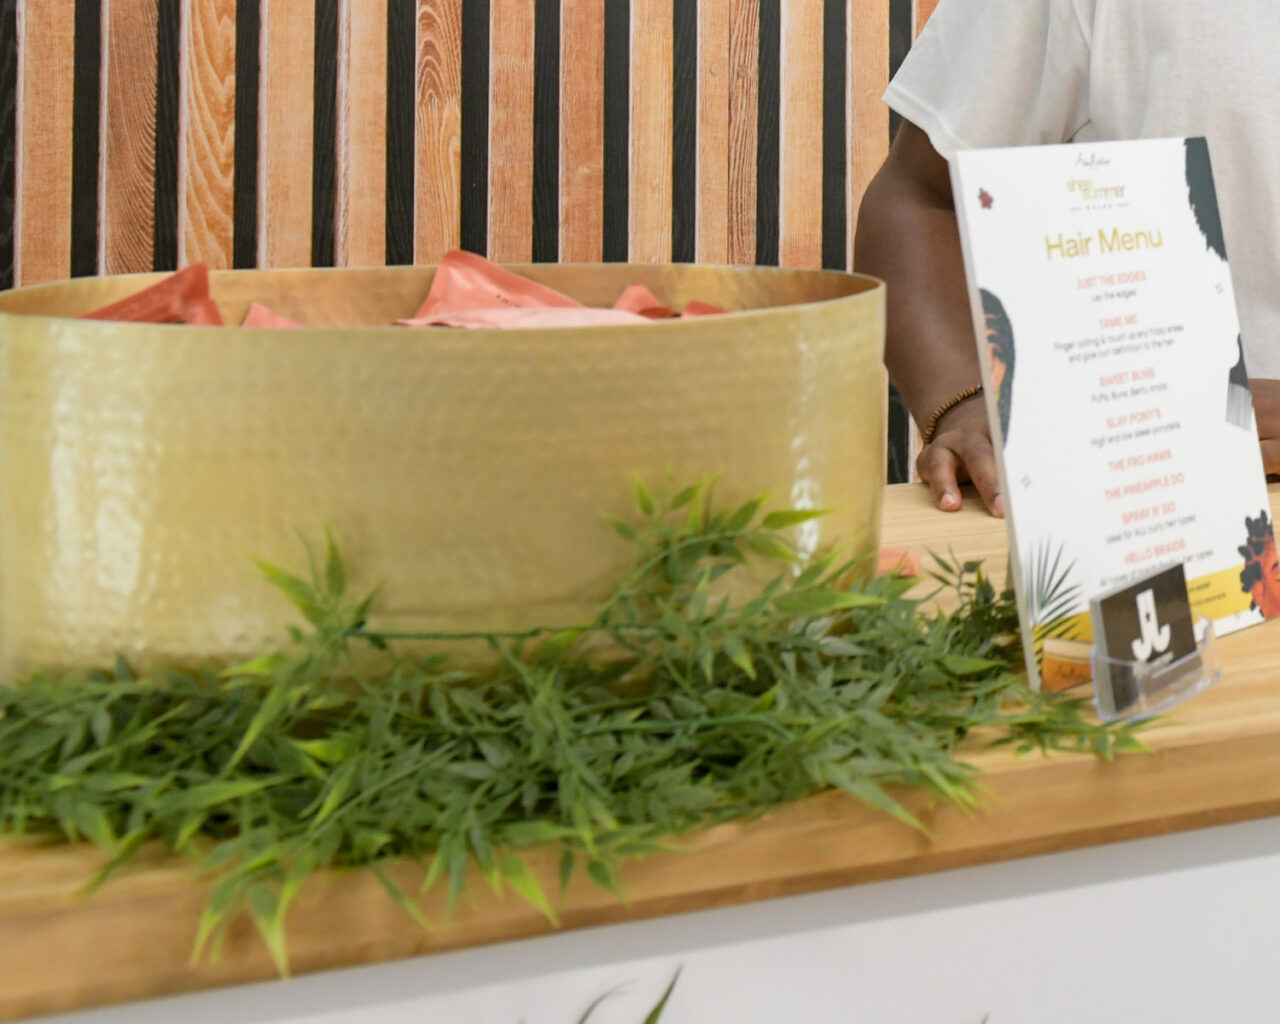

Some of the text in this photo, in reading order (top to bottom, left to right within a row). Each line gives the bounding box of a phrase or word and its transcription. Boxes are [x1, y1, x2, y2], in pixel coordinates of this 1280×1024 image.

[1045, 226, 1163, 260] Hair Menu
[1099, 273, 1116, 286] THE
[1118, 270, 1147, 284] EDGES
[1124, 313, 1138, 325] ME
[1108, 458, 1125, 471] THE
[1104, 471, 1185, 499] THE PINEAPPLE DO
[1162, 500, 1177, 513] GO
[1124, 549, 1153, 565] HELLO
